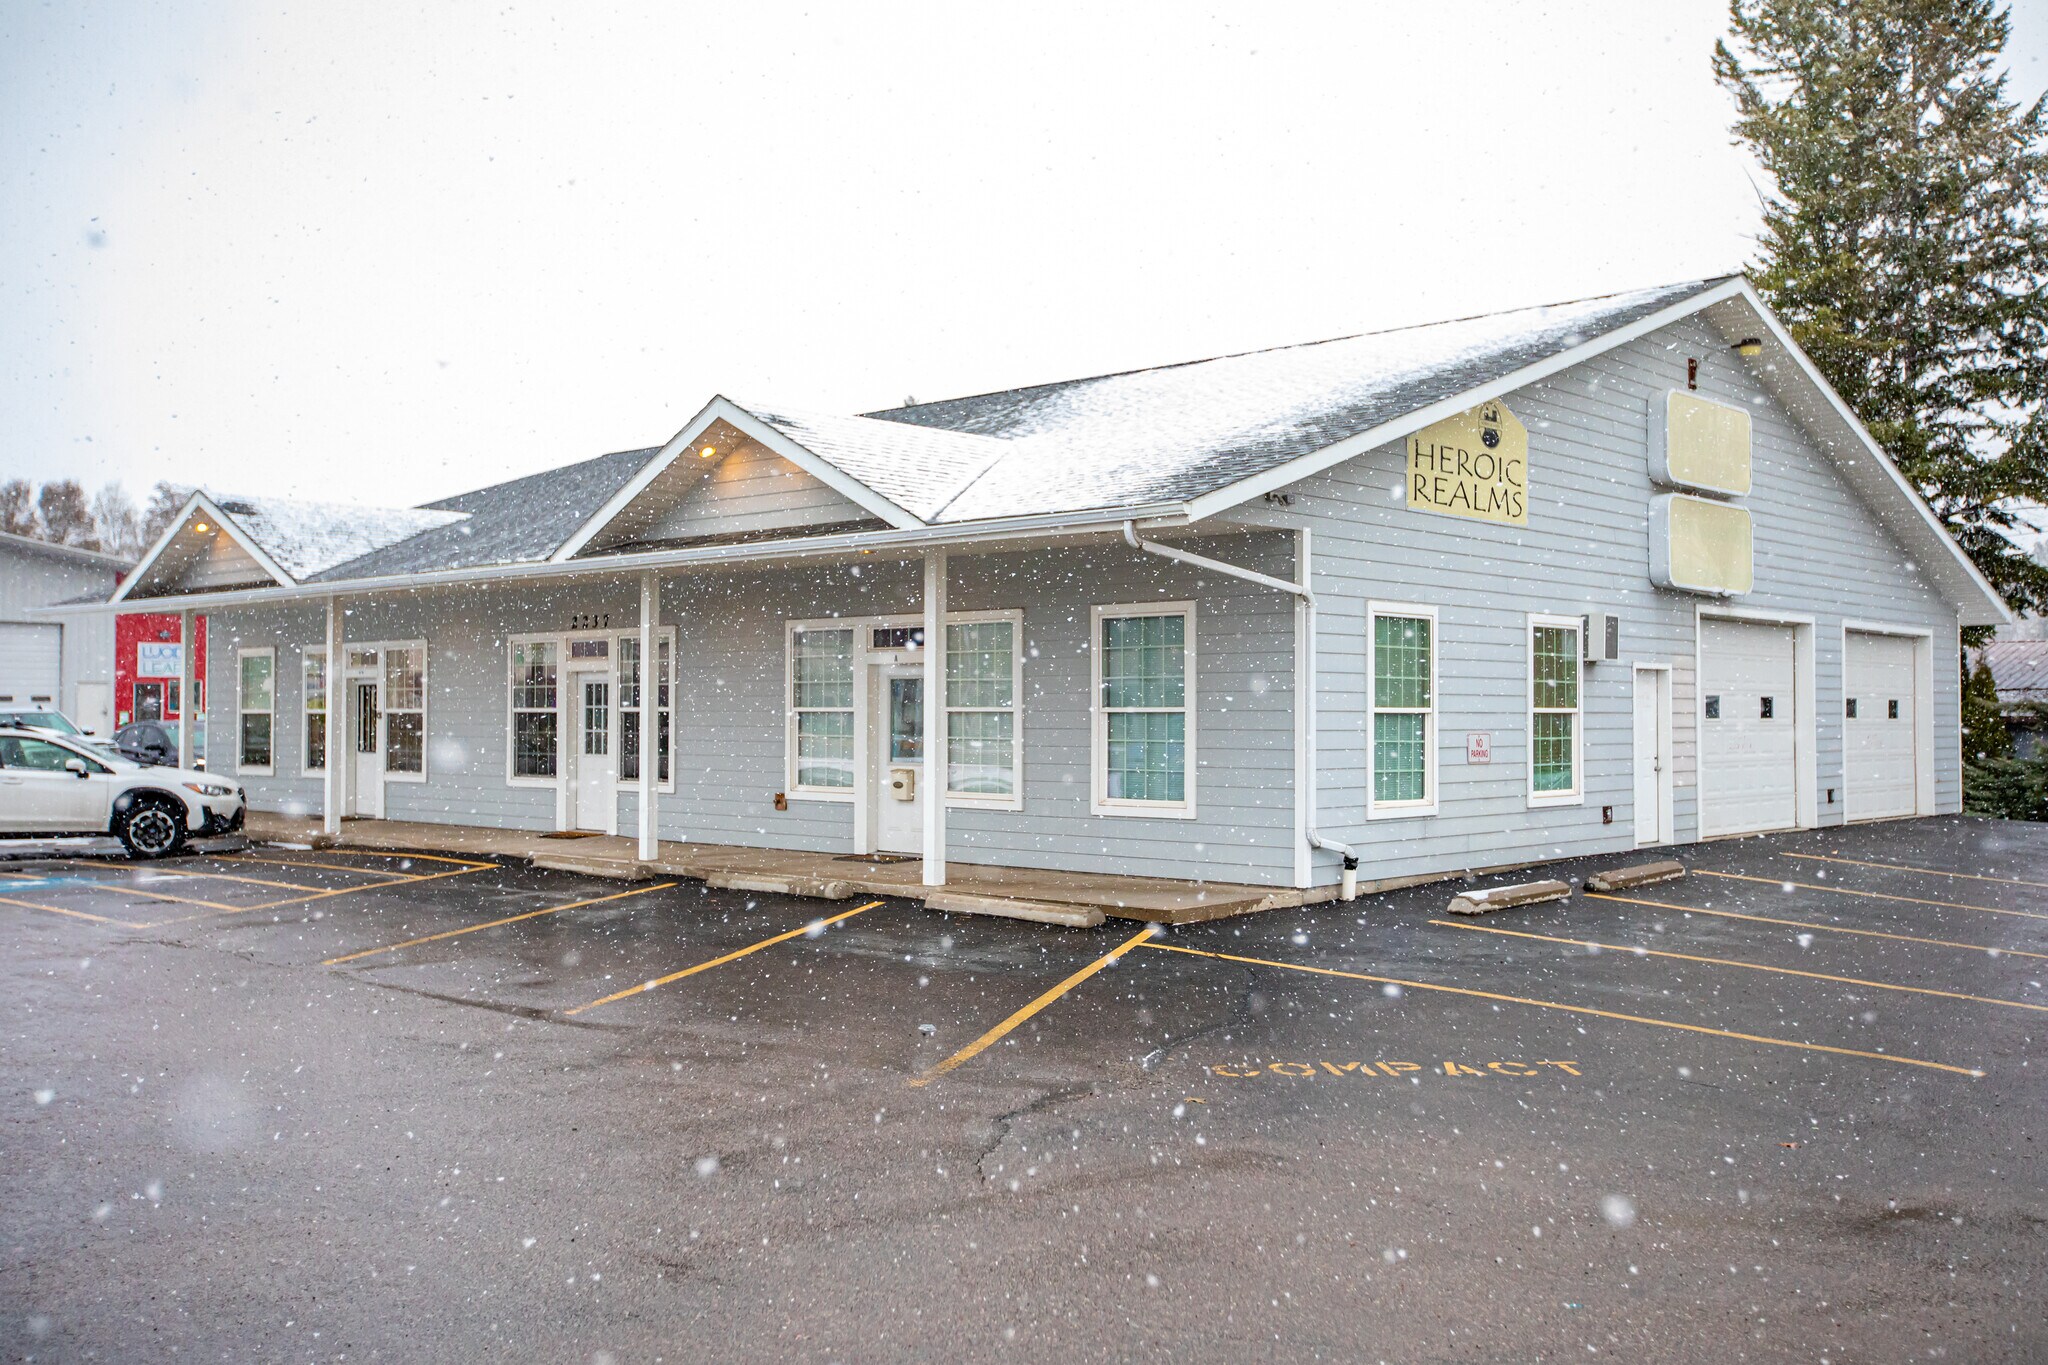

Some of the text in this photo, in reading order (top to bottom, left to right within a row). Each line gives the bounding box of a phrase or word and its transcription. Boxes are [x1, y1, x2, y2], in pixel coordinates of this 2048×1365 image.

[1414, 438, 1522, 488] HEROIC
[1413, 473, 1523, 518] REALMS
[1470, 749, 1489, 758] PARKING
[1475, 738, 1484, 748] NO
